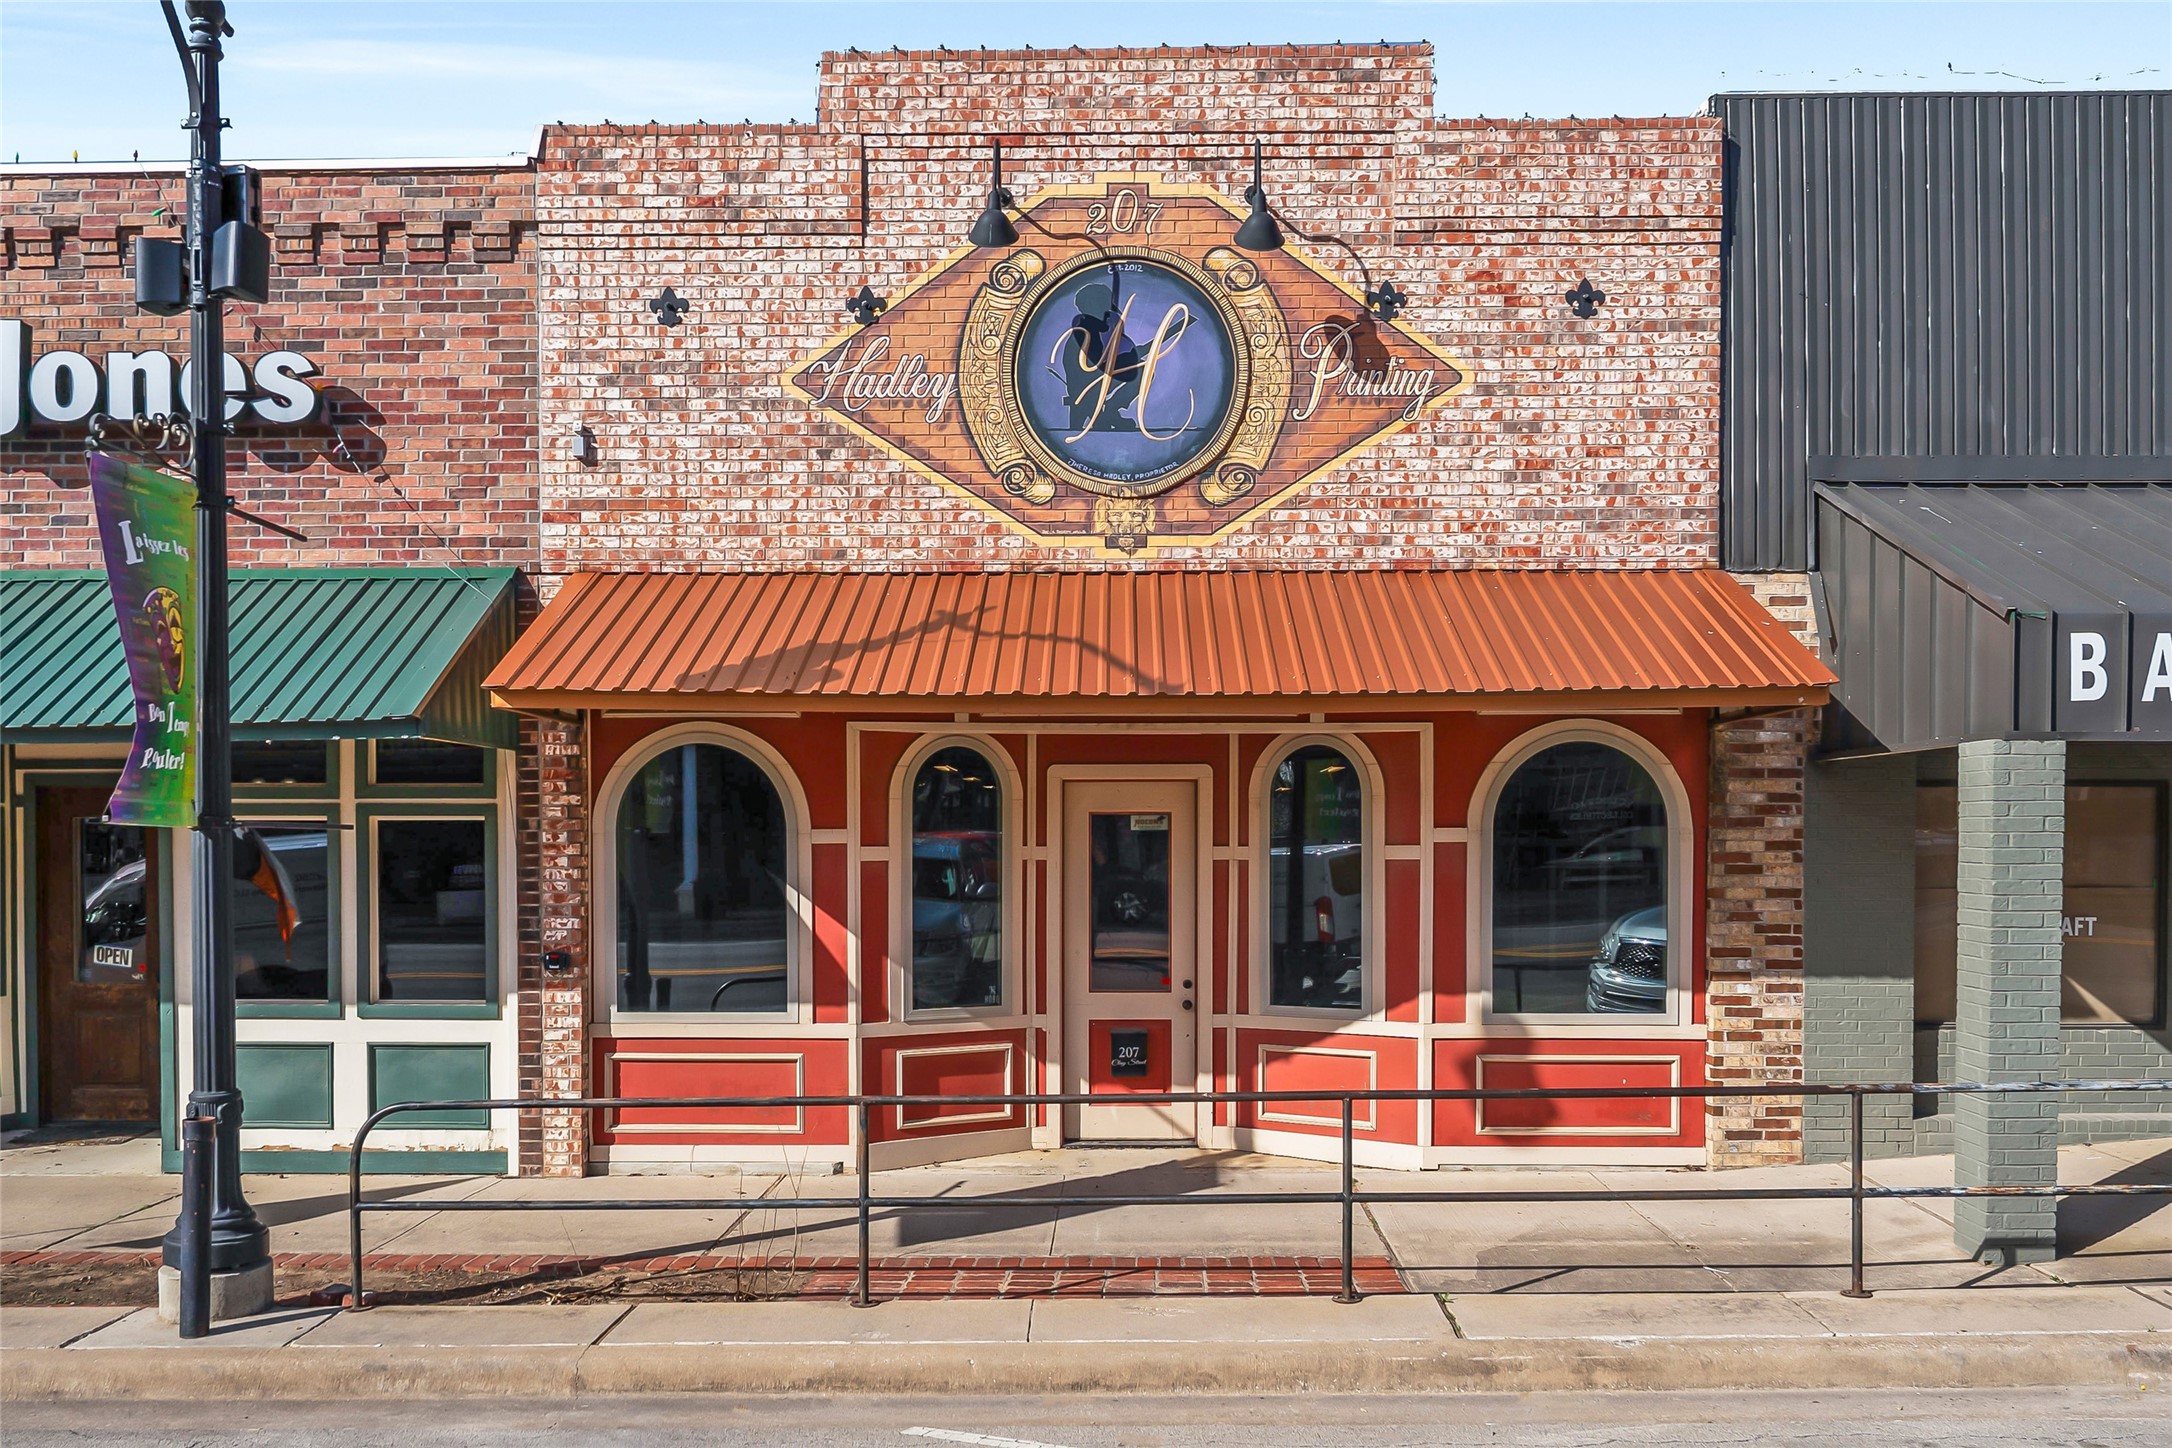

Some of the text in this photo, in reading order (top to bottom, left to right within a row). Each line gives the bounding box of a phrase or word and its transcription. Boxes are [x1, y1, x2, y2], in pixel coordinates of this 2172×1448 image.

[1085, 188, 1165, 235] 207
[808, 336, 959, 424] Hadley
[1292, 322, 1441, 422] Printing
[118, 520, 172, 565] Laissez
[148, 703, 166, 723] Bon
[96, 946, 130, 966] OPEN
[1118, 1046, 1140, 1058] 207
